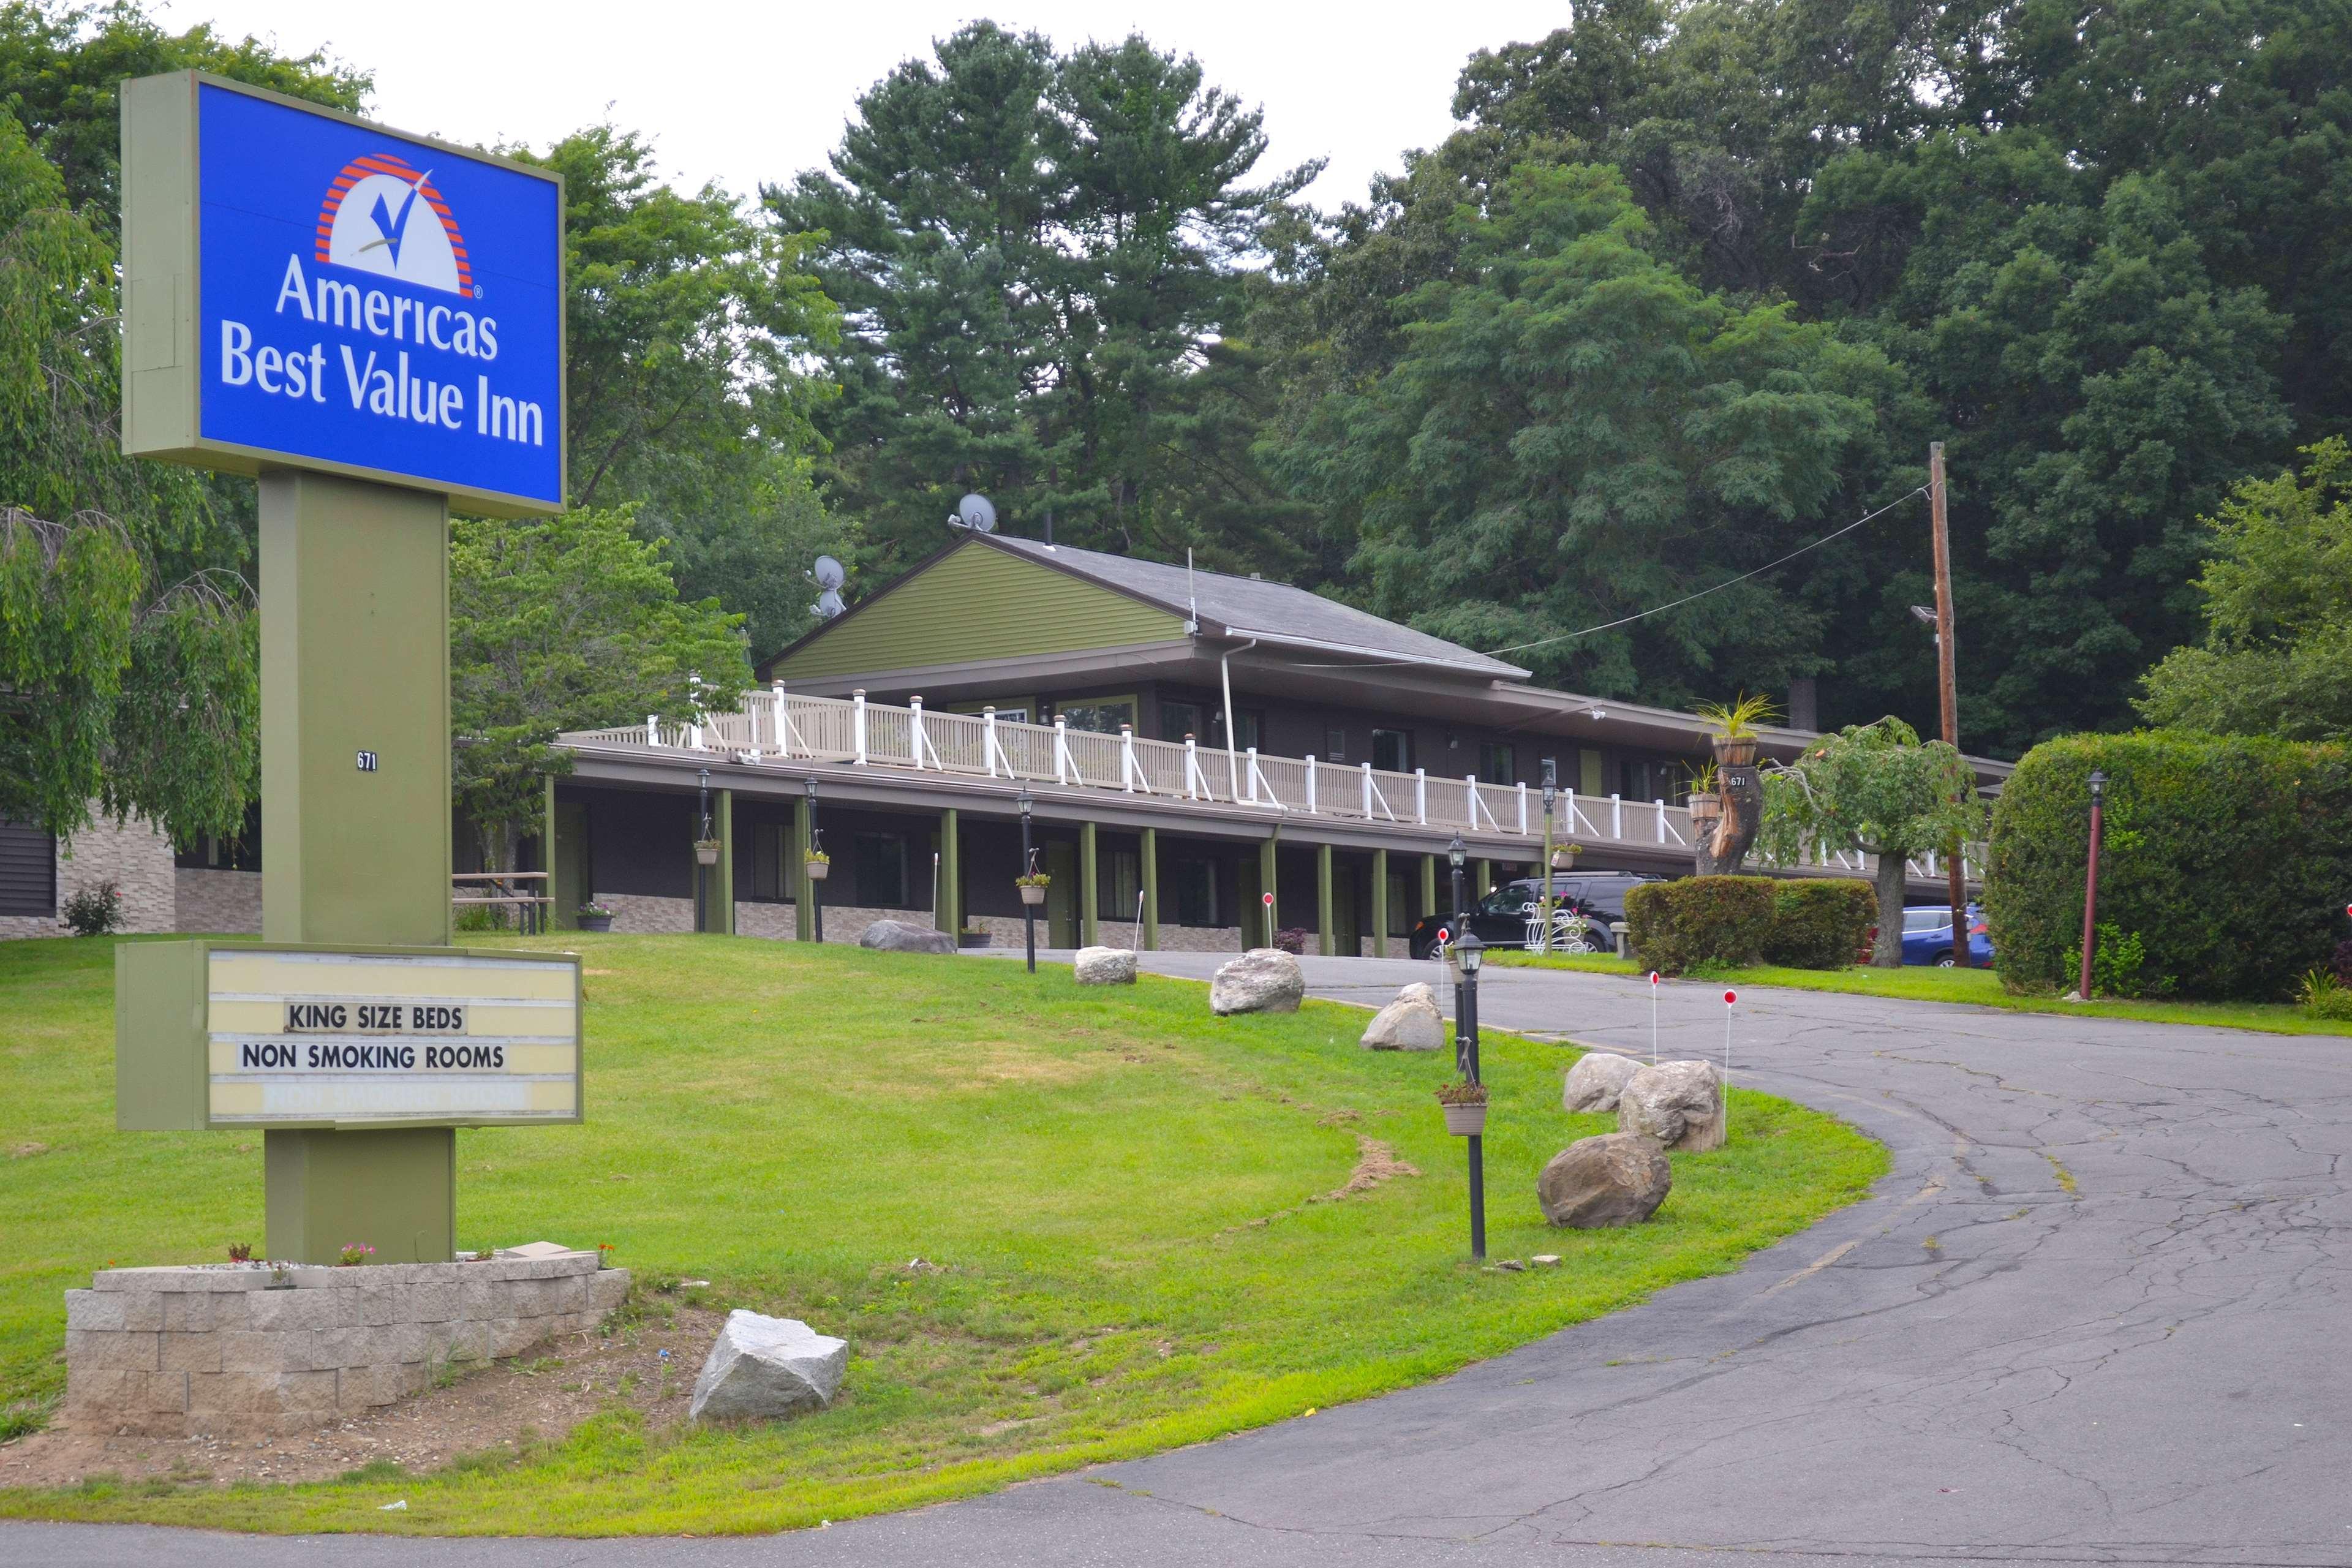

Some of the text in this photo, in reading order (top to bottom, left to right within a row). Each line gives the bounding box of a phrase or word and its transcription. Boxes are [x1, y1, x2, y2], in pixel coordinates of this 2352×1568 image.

[276, 253, 499, 361] Americas
[221, 319, 543, 447] Best Value Inn
[357, 752, 375, 769] 671
[1731, 777, 1745, 786] 671
[289, 1005, 463, 1030] KING SIZE BEDS
[243, 1044, 504, 1069] NON SMOKING ROOMS
